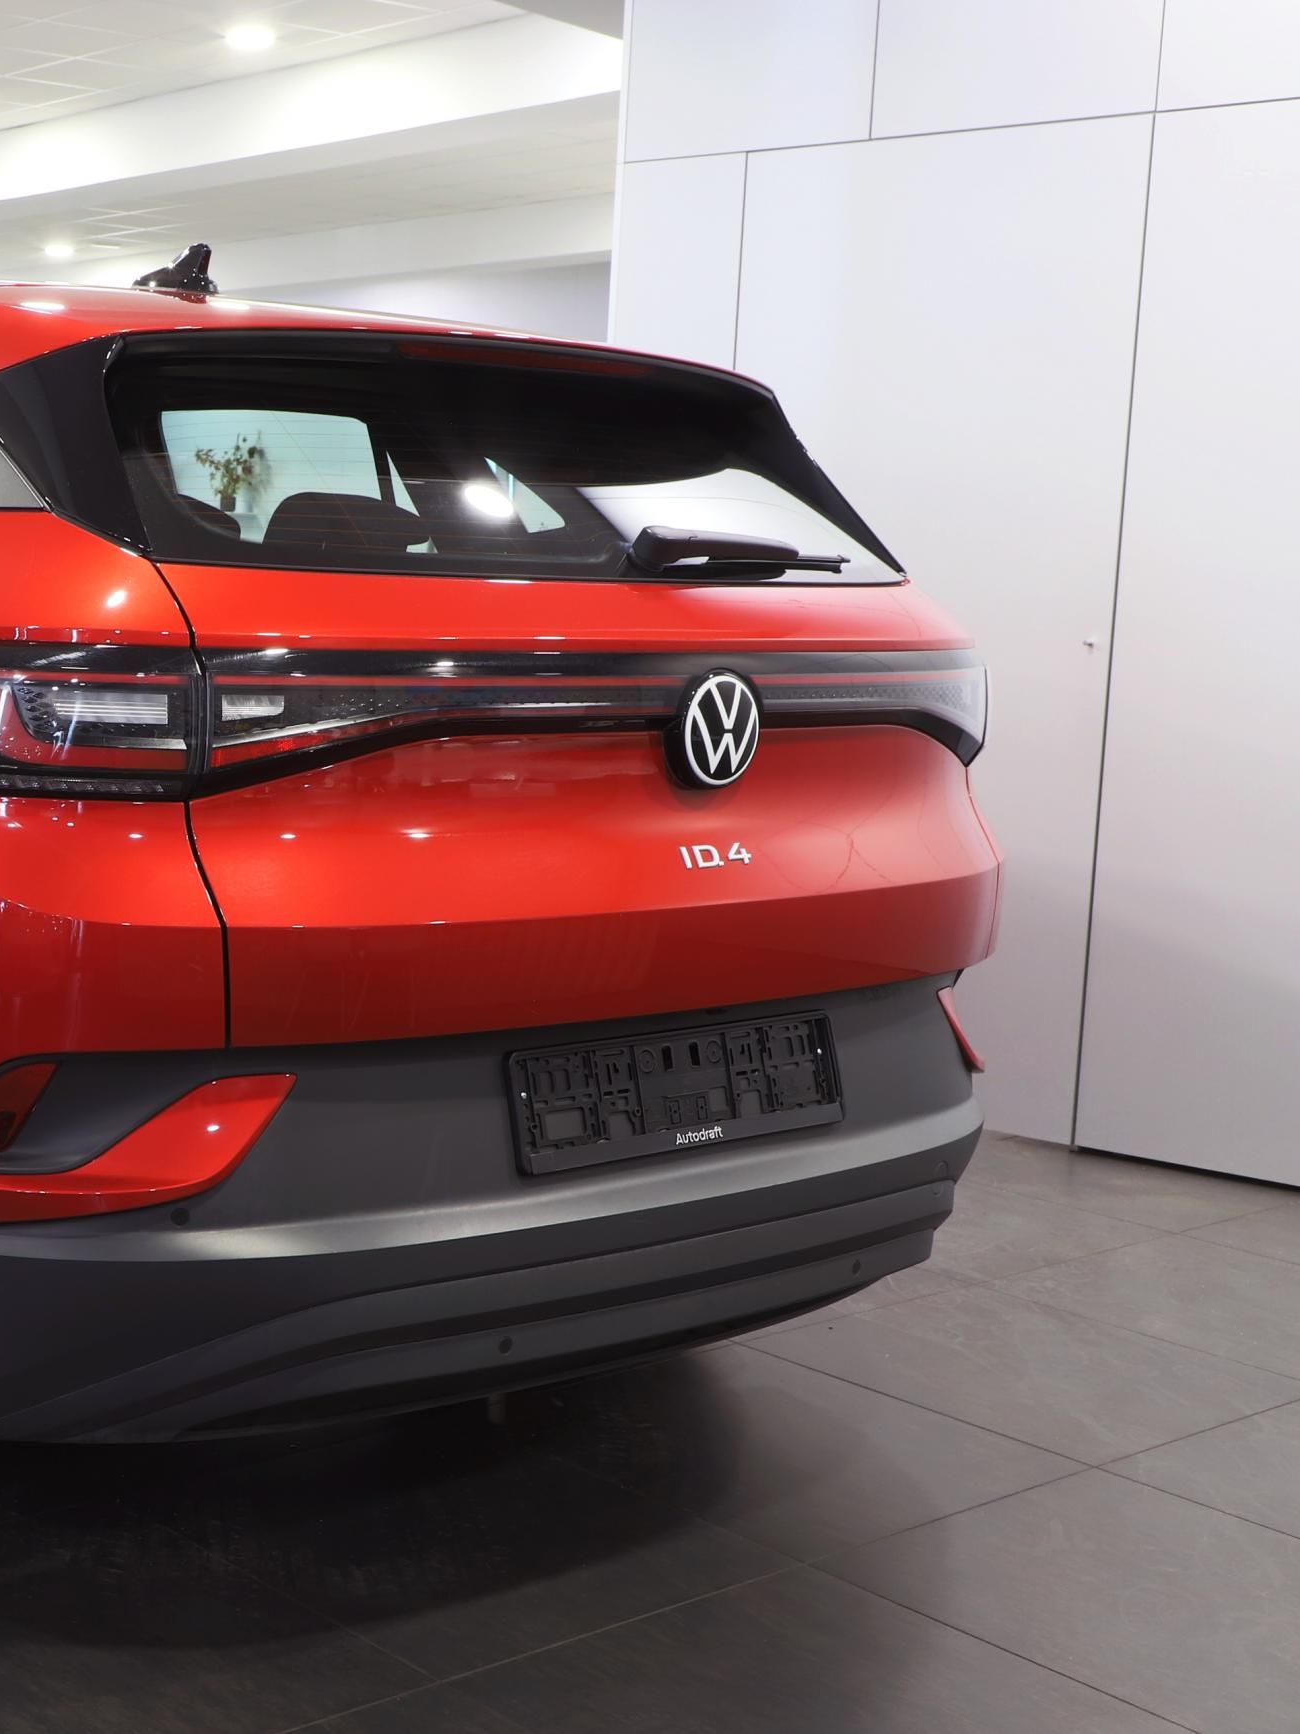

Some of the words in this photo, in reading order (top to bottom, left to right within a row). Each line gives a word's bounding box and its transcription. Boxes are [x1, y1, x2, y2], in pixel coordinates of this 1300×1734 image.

[686, 676, 759, 784] VW
[679, 842, 752, 869] ID.4
[676, 1125, 724, 1145] Autodraft
